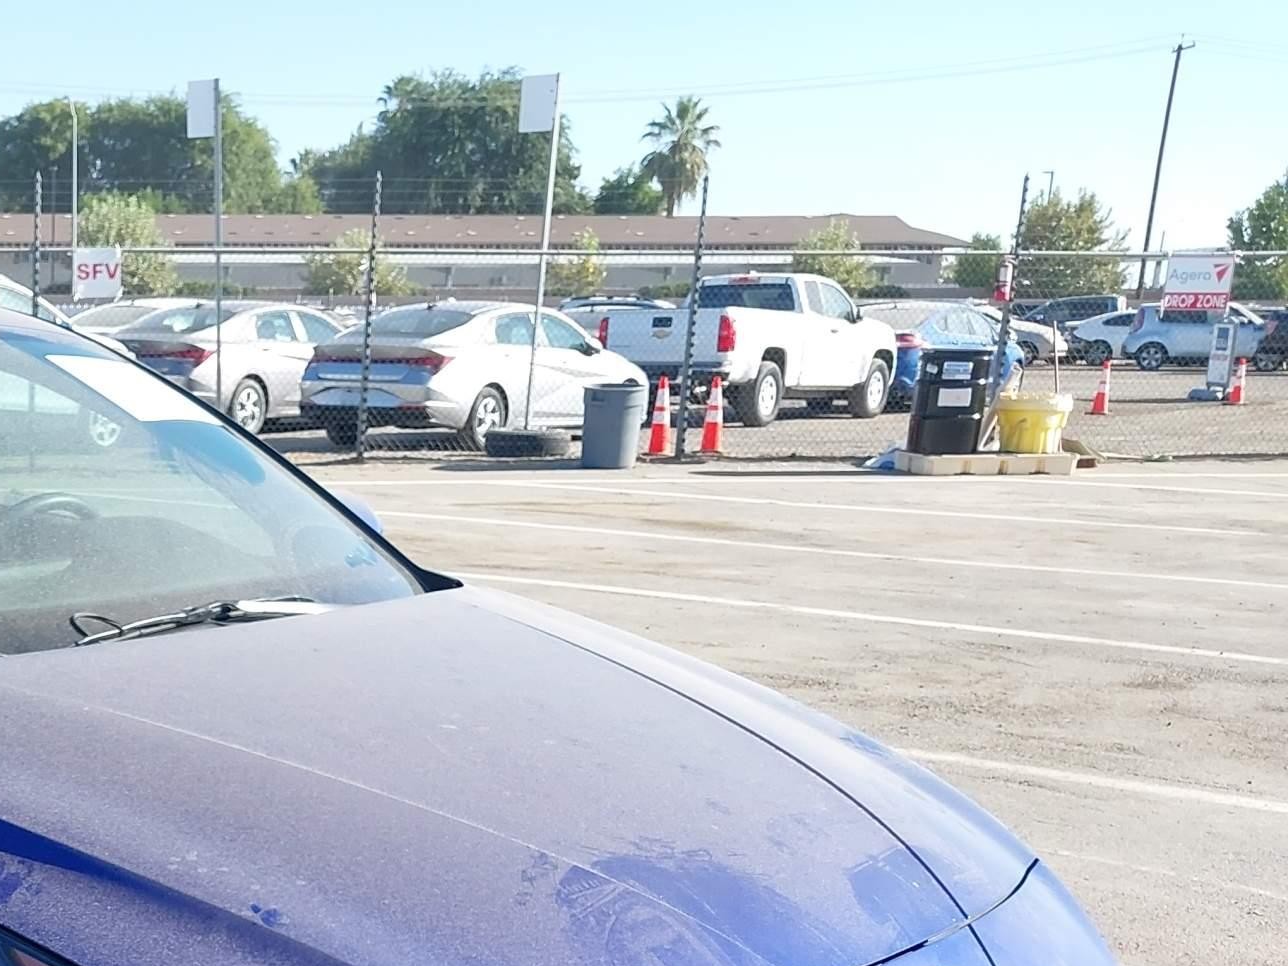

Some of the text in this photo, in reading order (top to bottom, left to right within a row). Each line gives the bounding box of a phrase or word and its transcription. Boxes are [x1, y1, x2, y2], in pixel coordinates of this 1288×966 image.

[77, 263, 119, 280] SFV
[1170, 268, 1212, 284] Agero
[1164, 294, 1227, 308] DROP ZONE
